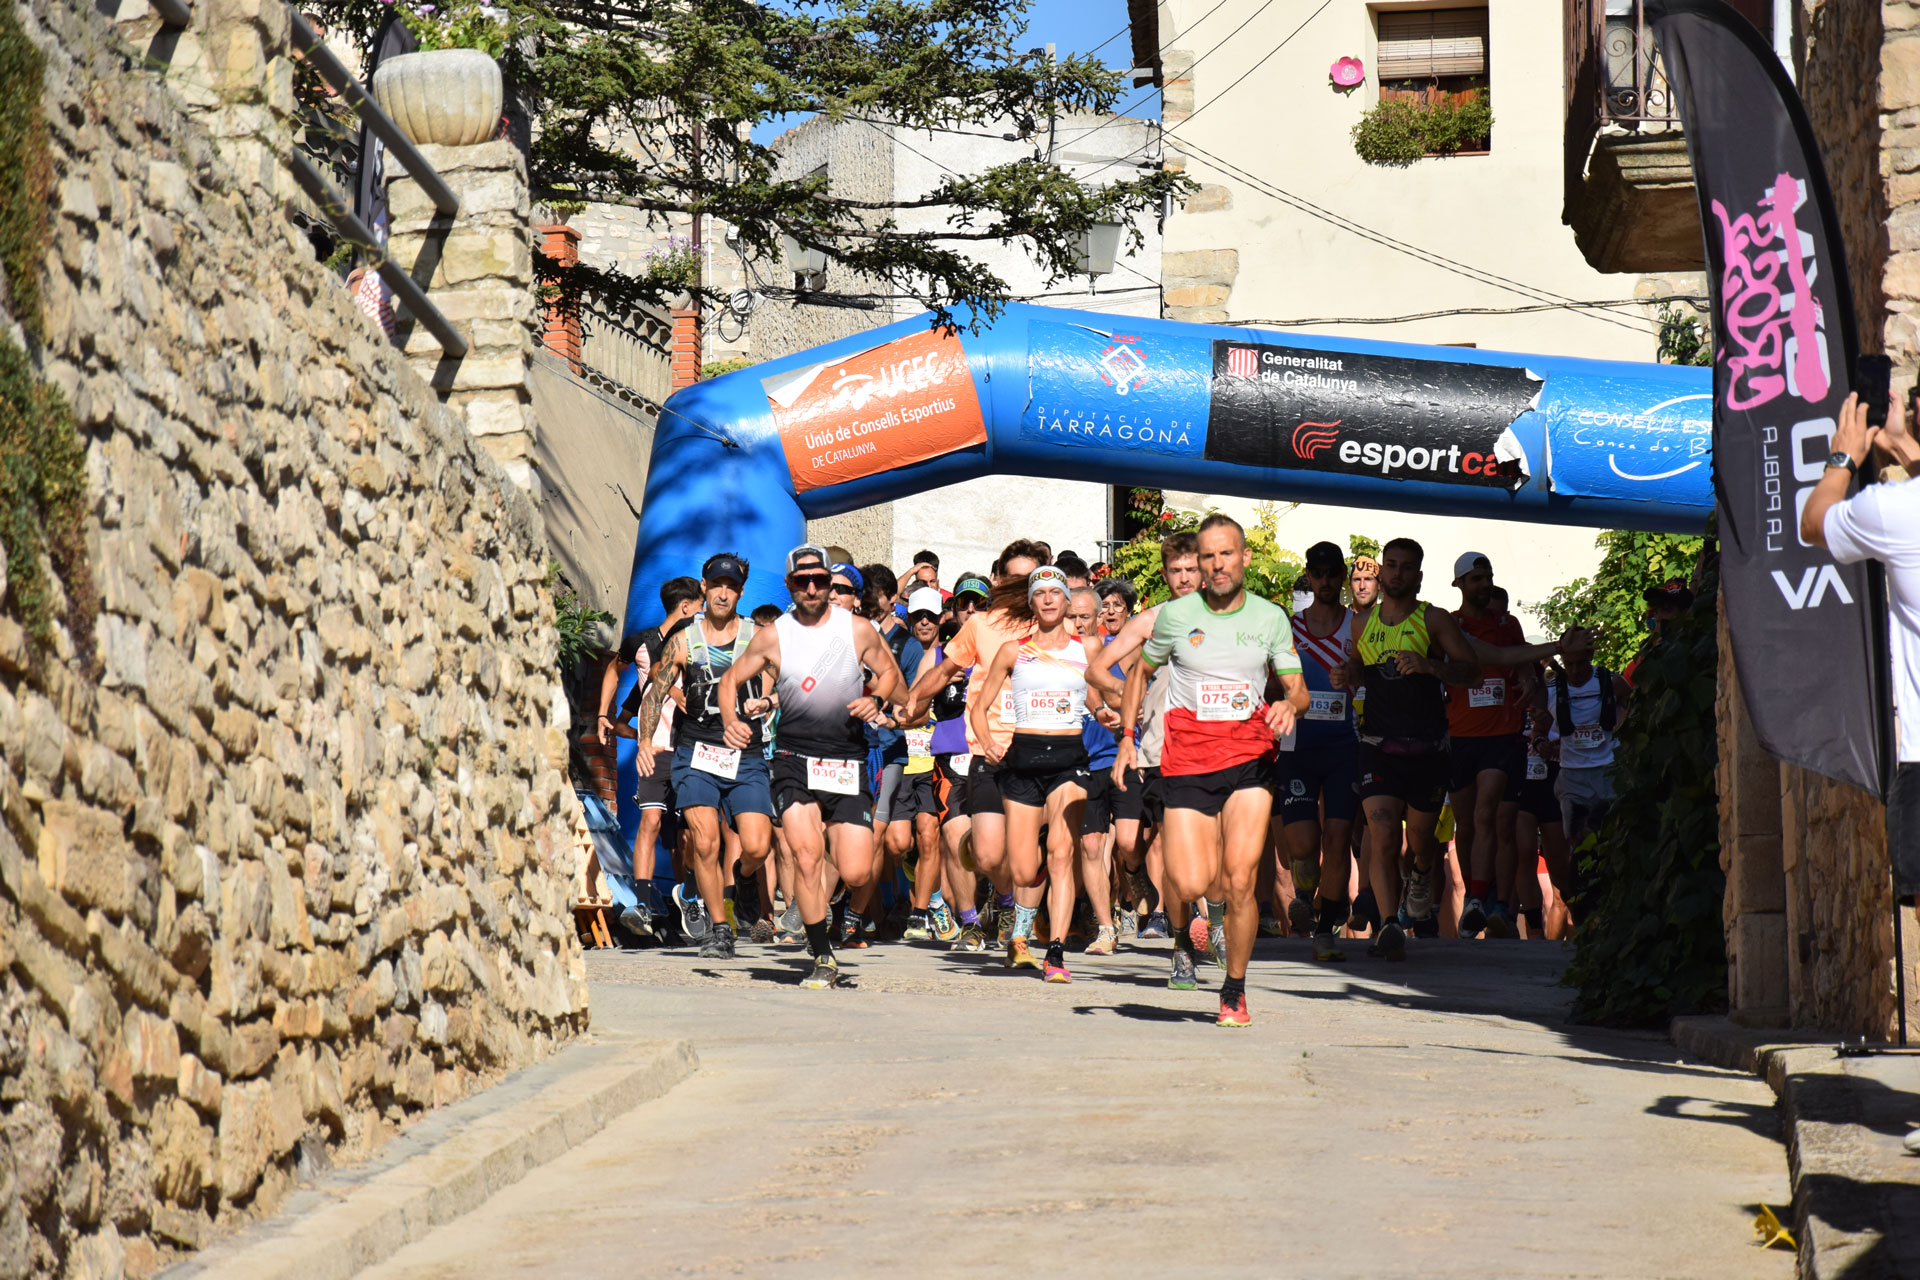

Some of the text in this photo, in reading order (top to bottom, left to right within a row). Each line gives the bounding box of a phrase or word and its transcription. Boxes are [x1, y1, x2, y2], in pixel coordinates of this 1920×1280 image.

[1262, 352, 1343, 371] Generalitat
[1261, 369, 1358, 394] de Catalunya
[805, 397, 956, 449] Unió de Consells Esportius
[1038, 406, 1191, 430] DIPUTACIÓ DE
[1578, 411, 1675, 432] CONSELL
[1038, 416, 1190, 446] TARRAGONA
[1574, 428, 1636, 449] Conca
[1650, 438, 1670, 452] de
[811, 441, 877, 469] DE CATALUNYA
[1339, 440, 1506, 477] esportca
[1031, 698, 1055, 709] 065
[1202, 692, 1230, 704] 075
[1311, 700, 1330, 710] 163
